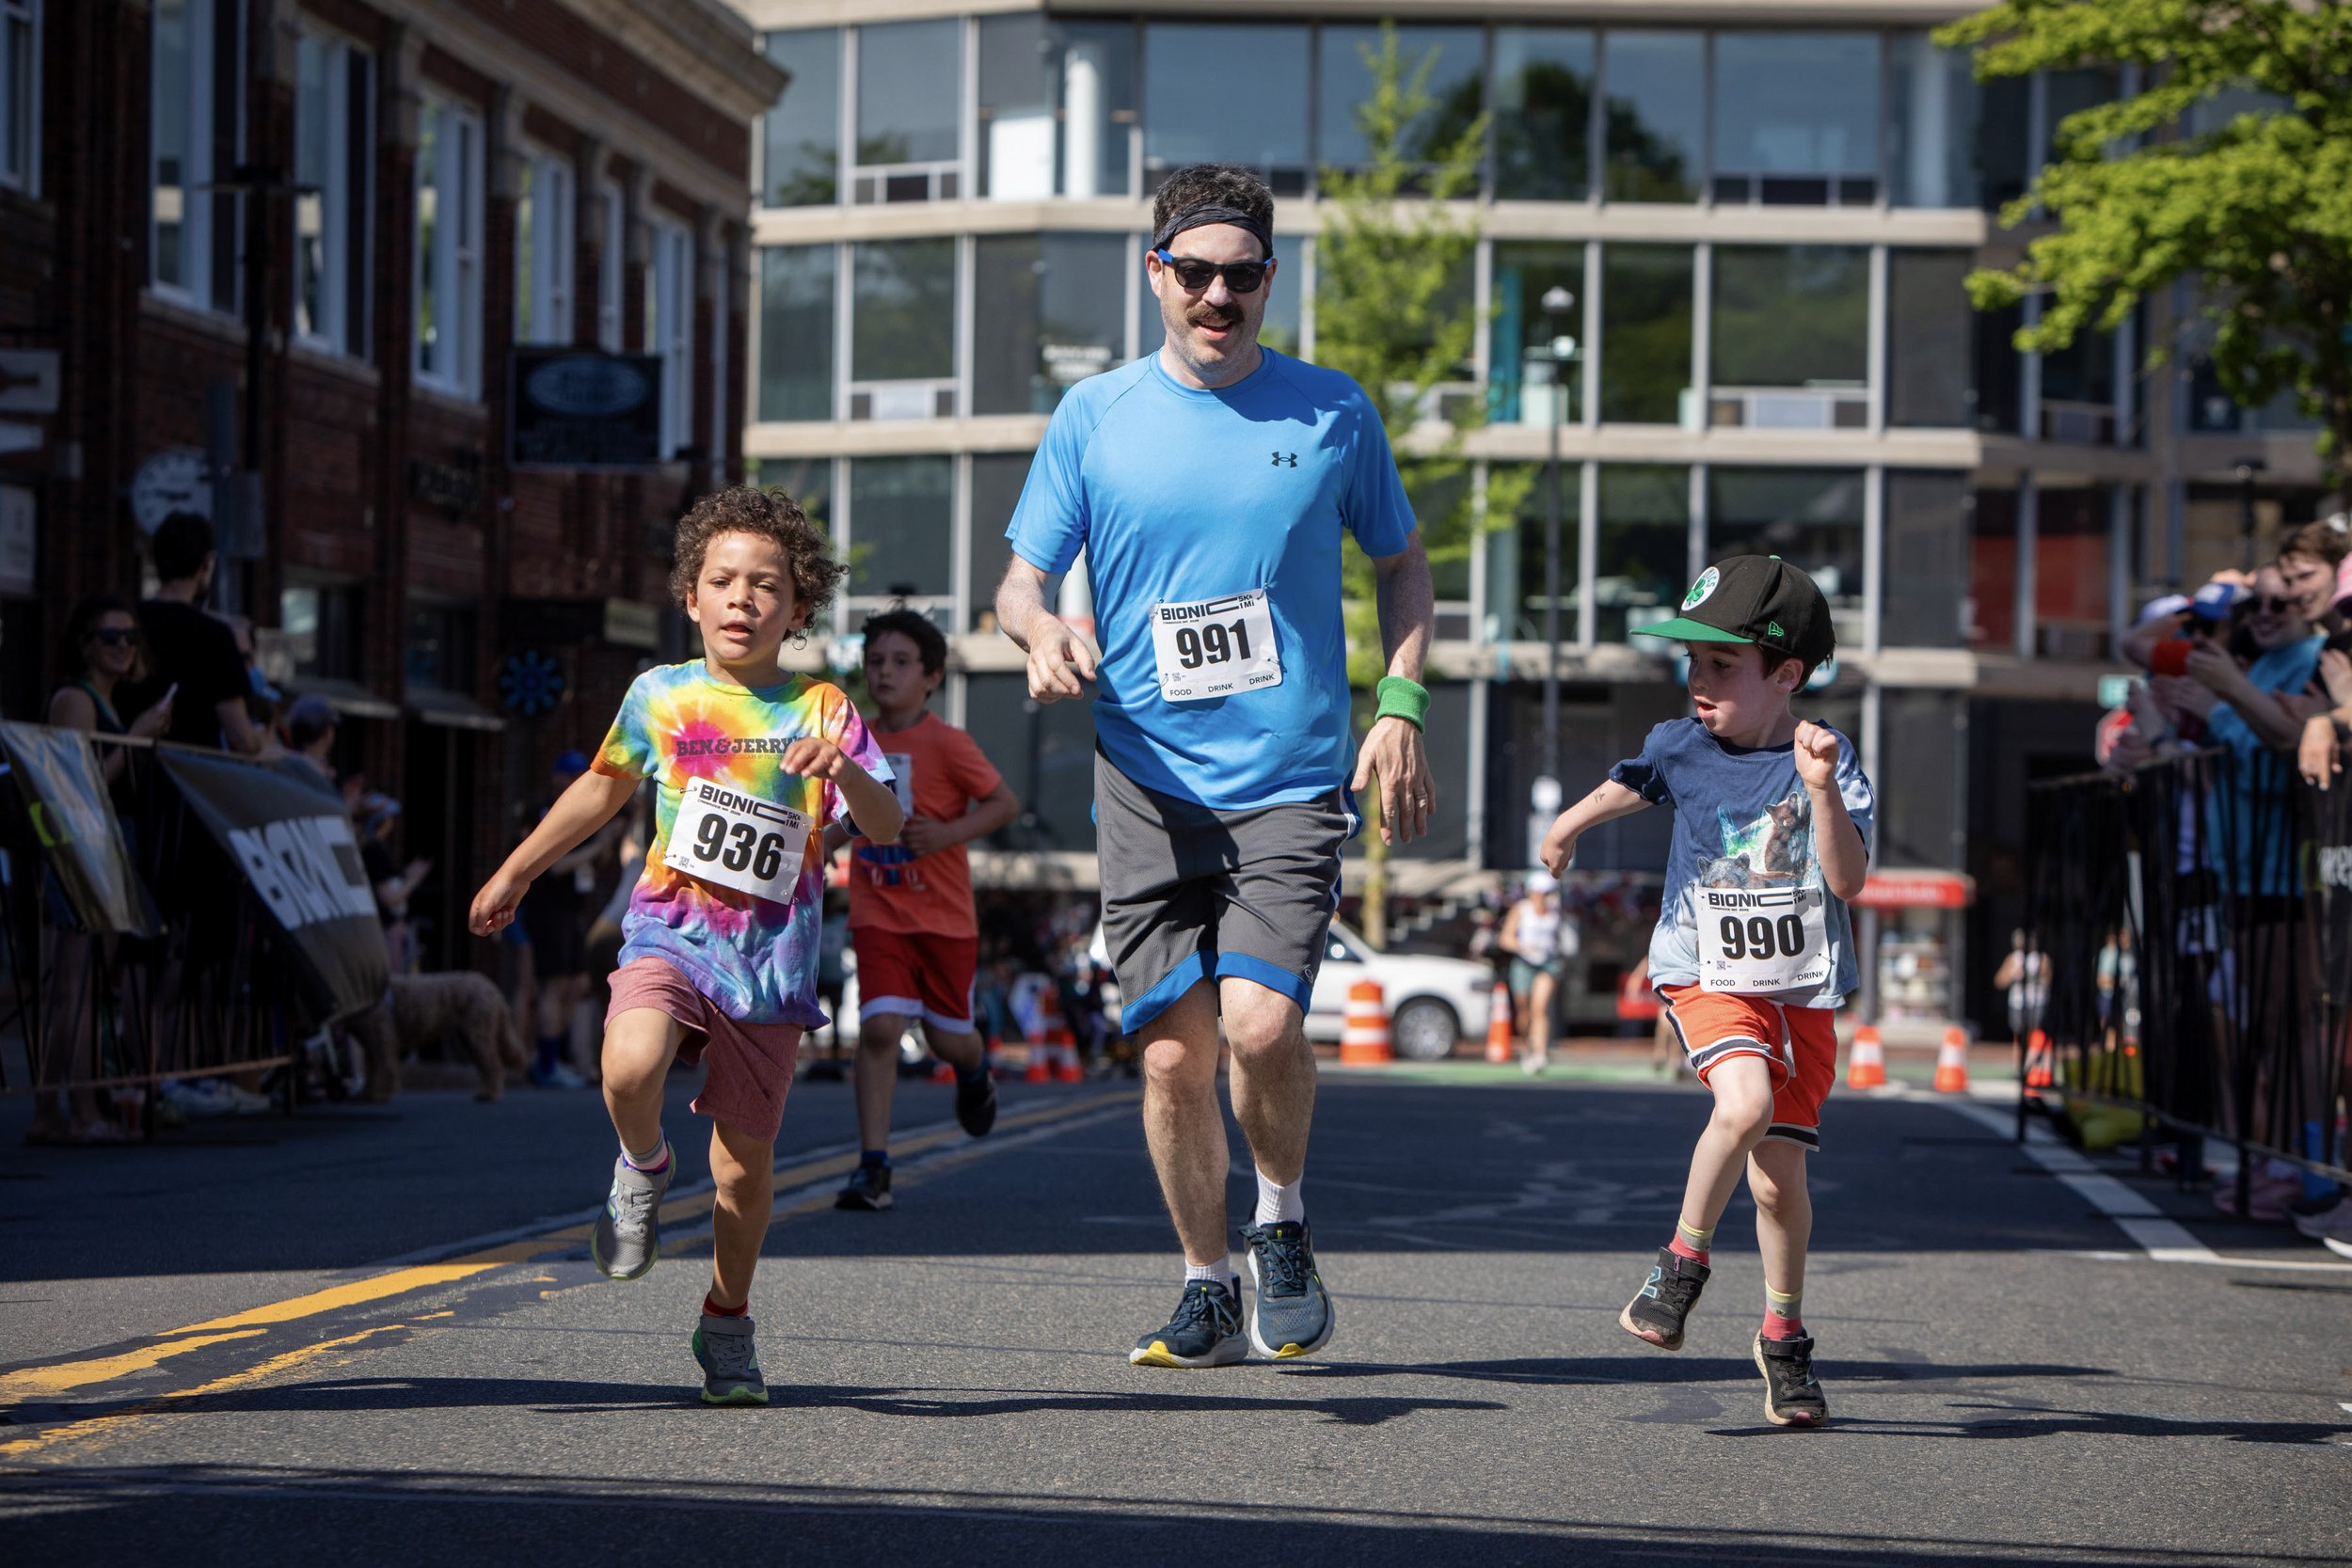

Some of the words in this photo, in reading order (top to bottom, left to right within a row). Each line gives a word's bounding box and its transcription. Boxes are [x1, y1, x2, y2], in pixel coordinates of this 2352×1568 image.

[1161, 597, 1239, 621] BIONIC
[1176, 618, 1251, 670] 991
[1169, 688, 1192, 697] FOOD
[1207, 683, 1234, 693] DRINK
[1248, 673, 1275, 685] DRINK
[699, 784, 787, 825] BIONIC
[692, 813, 785, 880] 936
[1708, 892, 1793, 908] BIONIC
[1720, 913, 1805, 960] 990
[1710, 978, 1736, 987] FOOD
[1752, 978, 1781, 987] DRINK
[1797, 970, 1824, 981] DRINK
